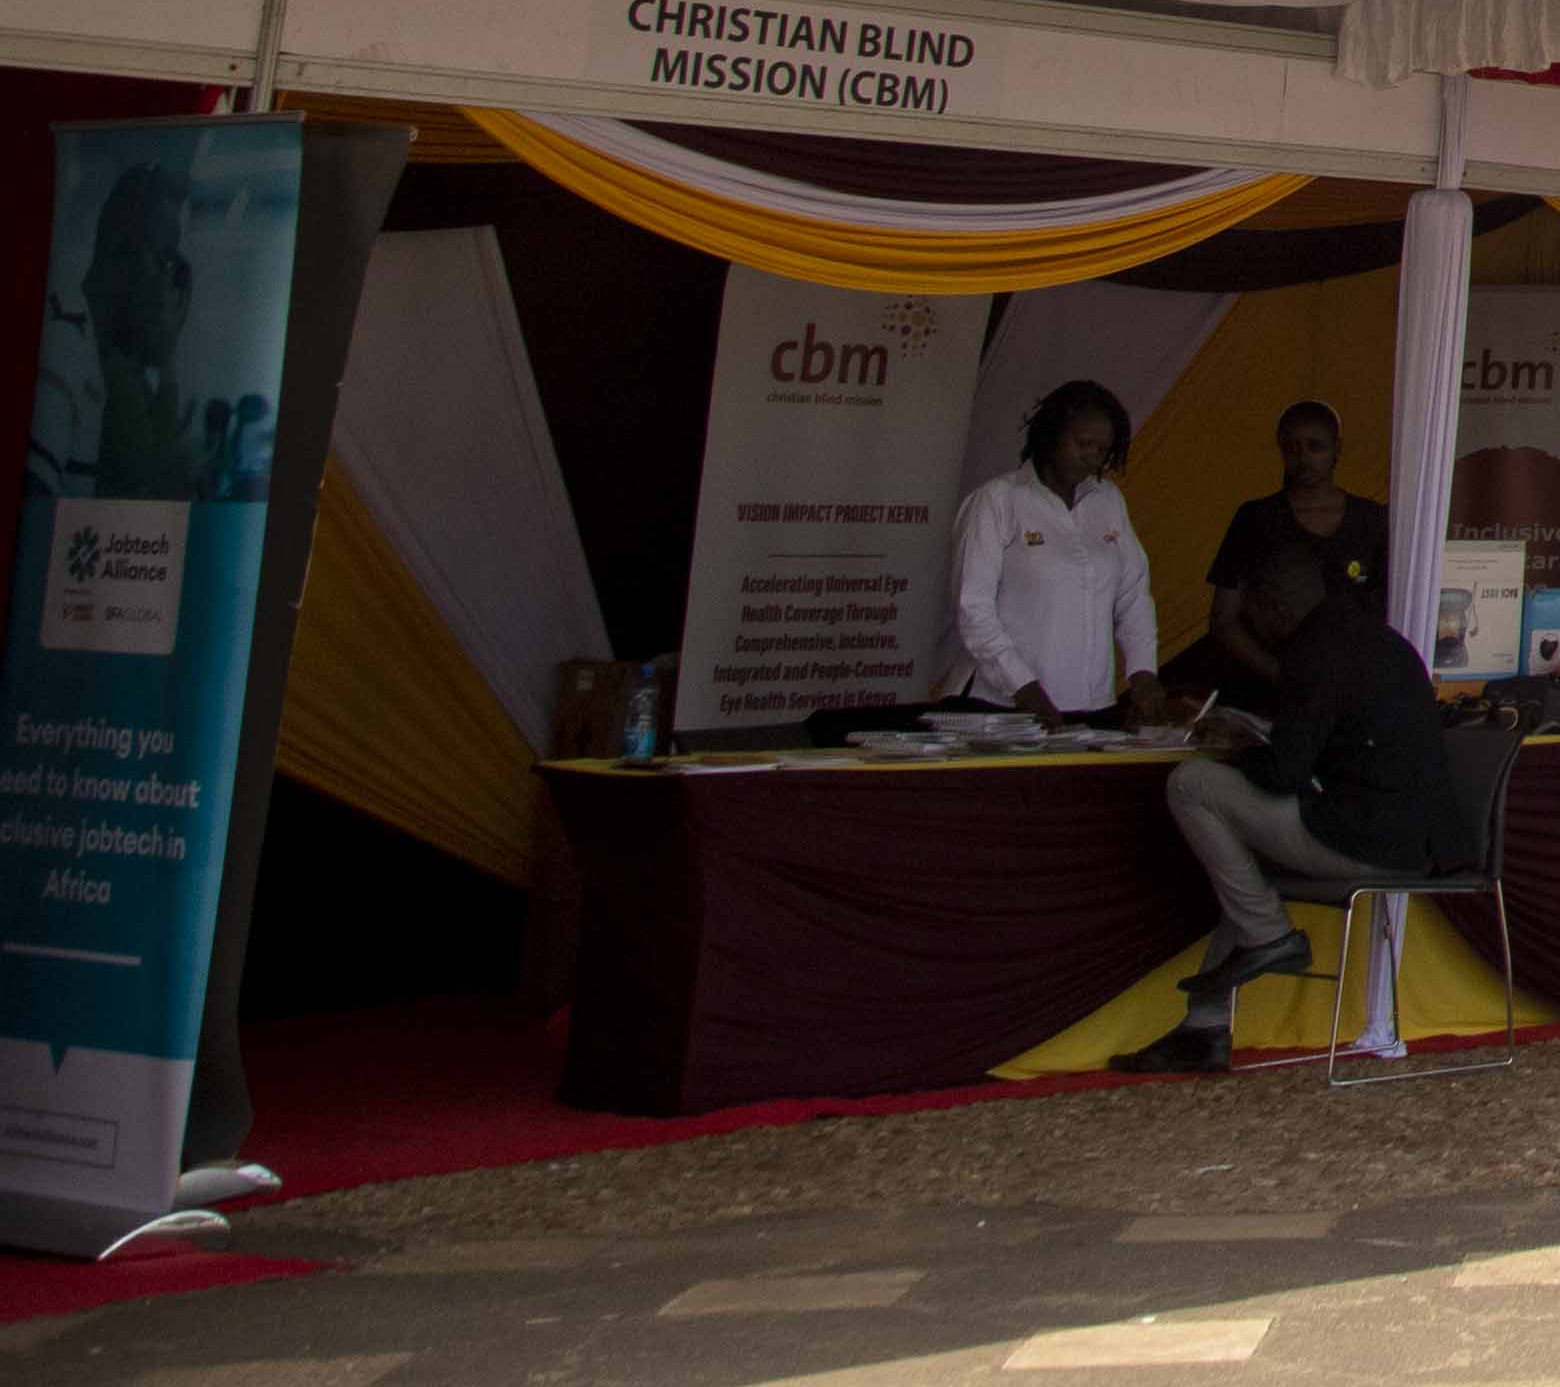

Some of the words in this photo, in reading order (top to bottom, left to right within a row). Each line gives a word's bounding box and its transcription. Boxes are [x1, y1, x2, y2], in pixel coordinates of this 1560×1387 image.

[858, 24, 974, 67] BLIND
[651, 48, 827, 100] MISSION
[838, 68, 949, 114] (CBM)
[770, 323, 889, 385] cbm
[1462, 349, 1553, 390] cbm
[738, 502, 779, 523] VISION
[783, 503, 830, 523] IMPACT
[834, 504, 884, 524] PROJECT
[888, 505, 929, 524] KENYA
[103, 531, 169, 556] Jobtech
[101, 560, 168, 581] Alliance
[741, 575, 823, 596] Accelerating
[826, 575, 882, 594] Universal
[884, 576, 909, 596] Eye
[742, 604, 782, 624] Health
[785, 604, 844, 626] Coverage
[845, 604, 897, 624] Through
[713, 664, 781, 684] Integrated
[783, 662, 809, 679] and
[720, 694, 741, 715] Eye
[743, 692, 786, 712] Health
[16, 713, 132, 759] Everything
[136, 730, 176, 760] you
[0, 765, 44, 795] eed
[48, 770, 67, 798] to
[72, 767, 131, 804] know
[133, 771, 203, 812] about
[0, 812, 76, 851] clusive
[77, 818, 165, 858] jobtech
[167, 829, 188, 860] in
[42, 868, 112, 907] Africa
